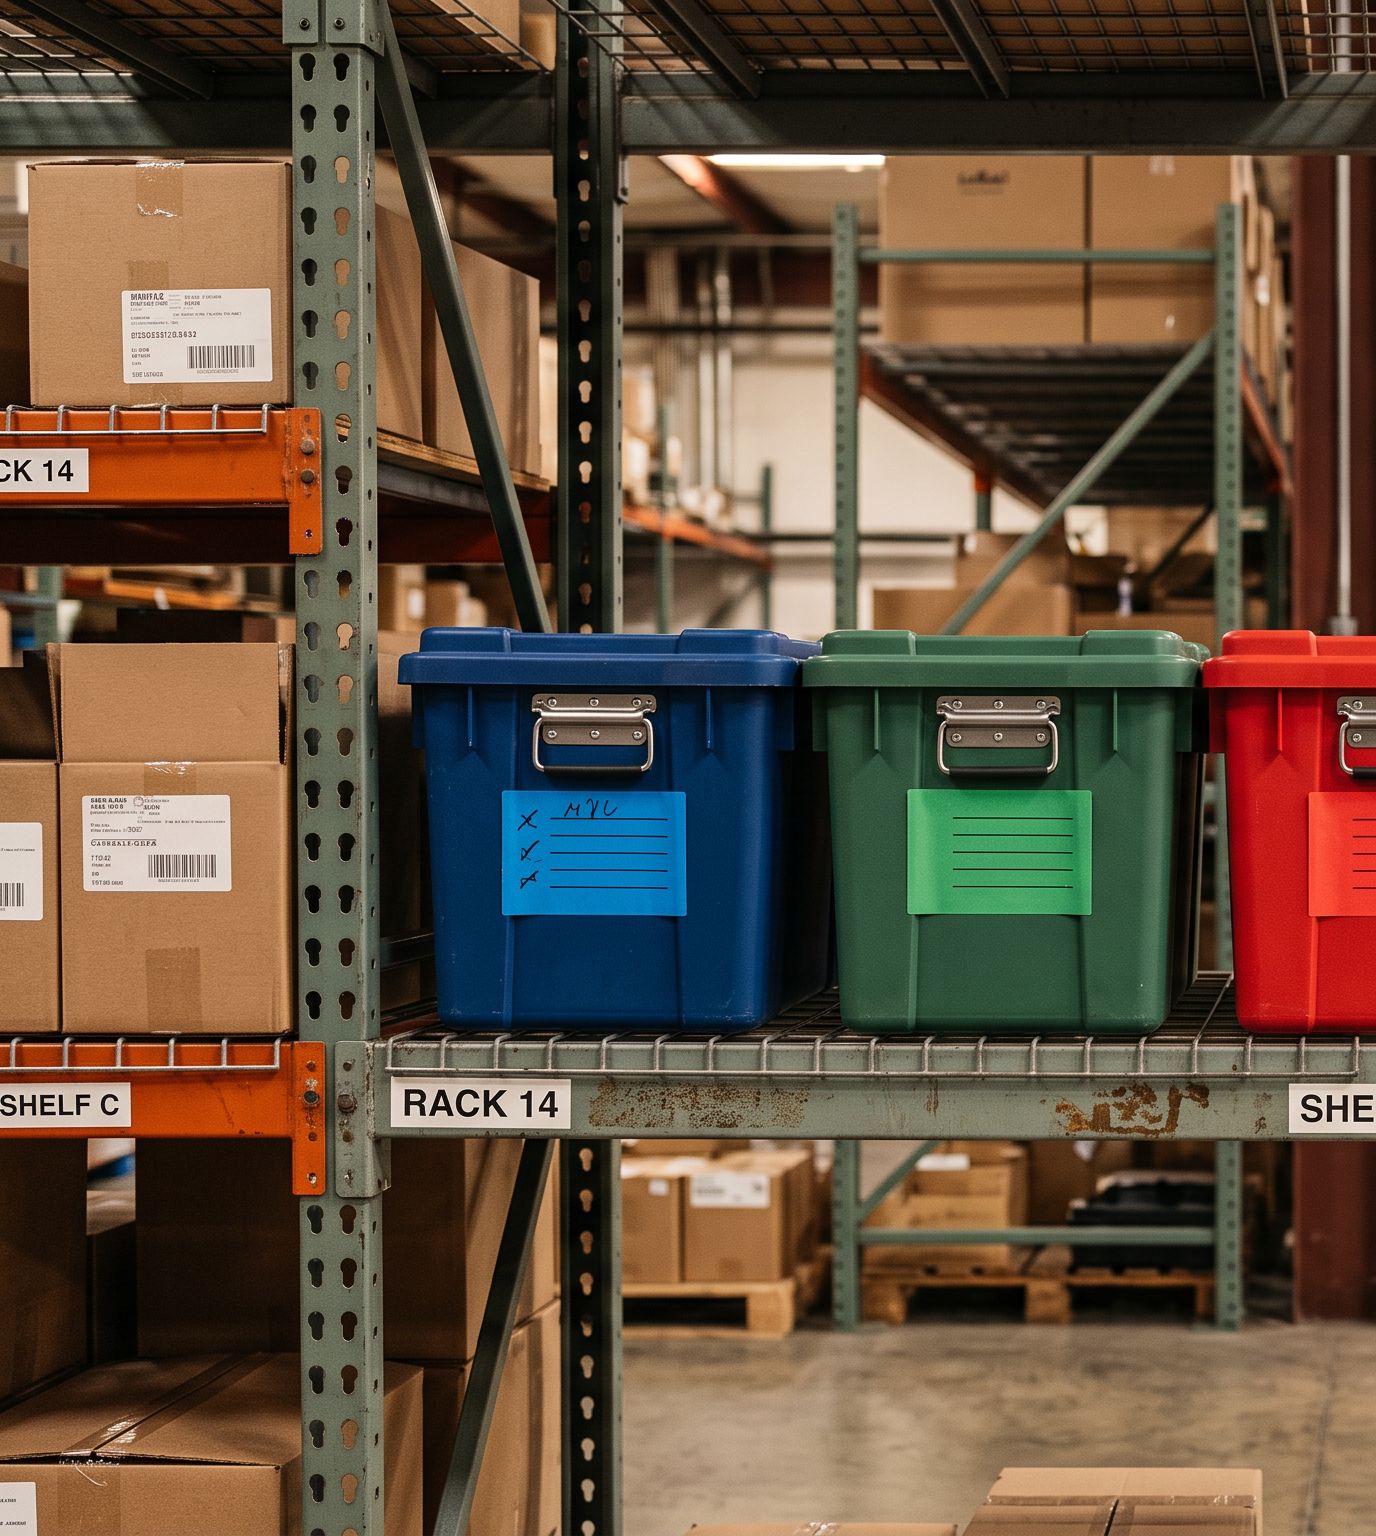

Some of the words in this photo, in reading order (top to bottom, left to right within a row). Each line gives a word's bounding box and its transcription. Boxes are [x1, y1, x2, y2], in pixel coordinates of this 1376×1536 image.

[42, 459, 74, 482] 14
[0, 1093, 91, 1117] SHELF
[100, 1093, 119, 1116] C
[404, 1088, 508, 1118] RACK
[520, 1090, 559, 1118] 14
